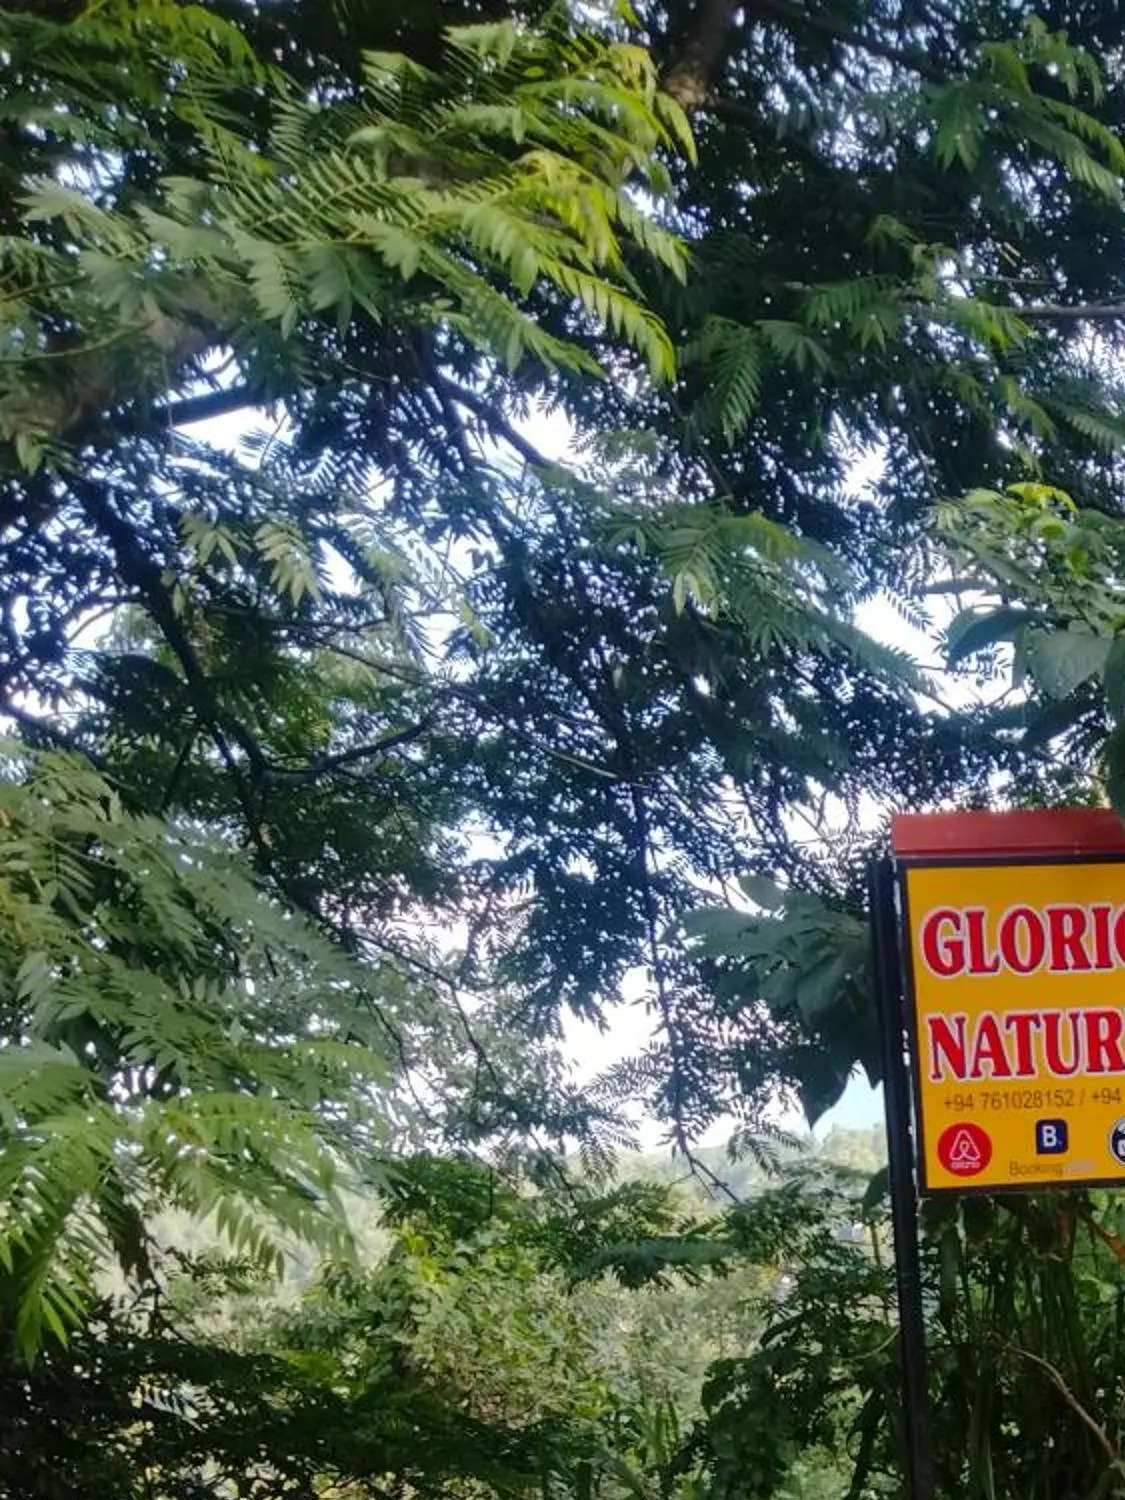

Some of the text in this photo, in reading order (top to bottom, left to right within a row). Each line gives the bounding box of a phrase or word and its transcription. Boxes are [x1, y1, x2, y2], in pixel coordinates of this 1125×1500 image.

[944, 1094, 974, 1112] +94
[982, 1089, 1074, 1111] 761028152
[1092, 1087, 1121, 1105] +94
